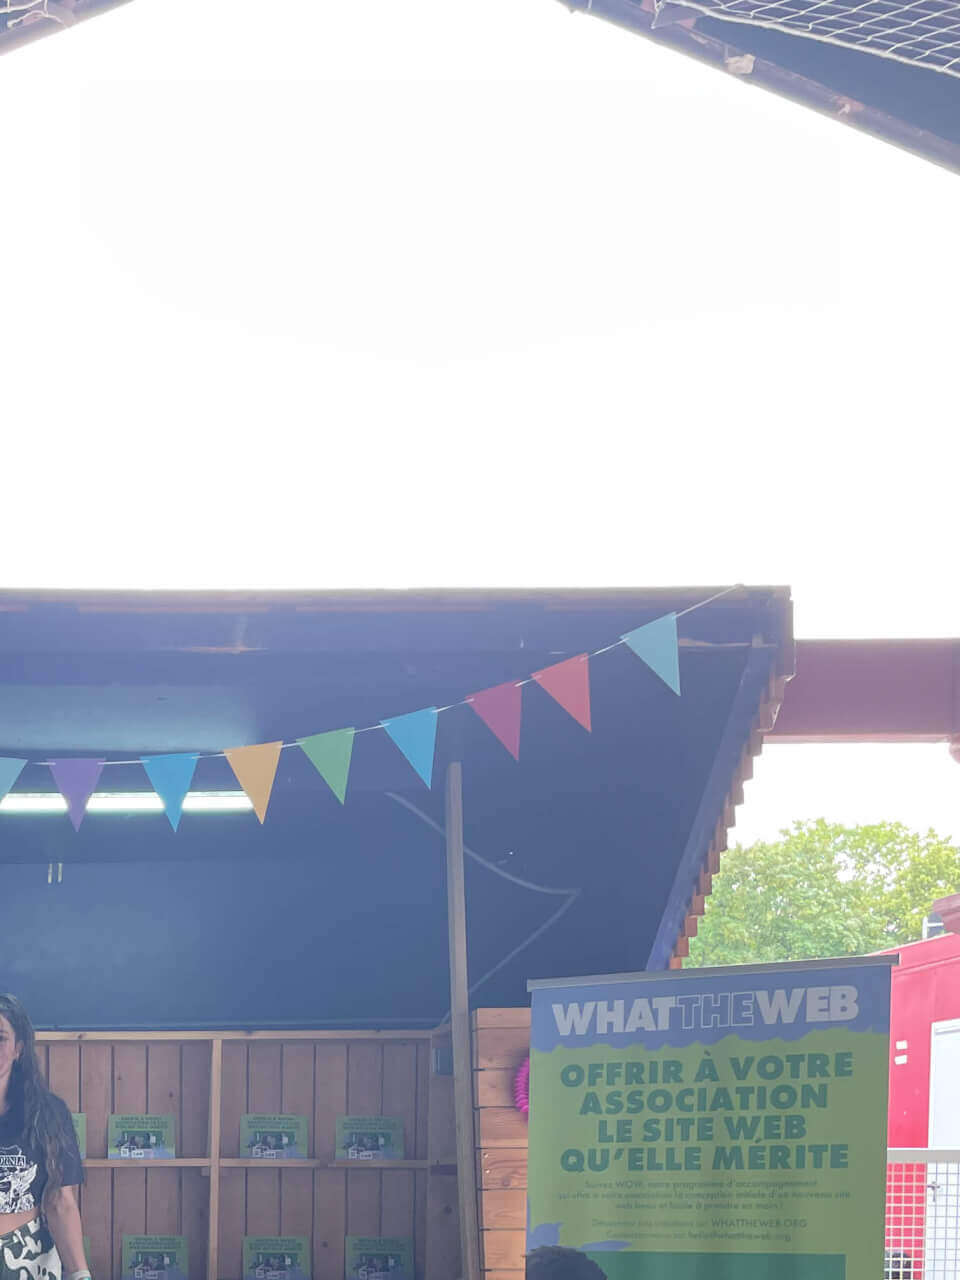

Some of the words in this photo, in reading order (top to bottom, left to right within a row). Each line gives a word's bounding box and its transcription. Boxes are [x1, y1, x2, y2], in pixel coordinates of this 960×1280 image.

[560, 1060, 683, 1087] OFFRIR
[694, 1050, 720, 1082] À
[729, 1051, 853, 1081] VOTRE
[579, 1083, 828, 1115] ASSOCIATION
[598, 1119, 633, 1143] LE
[643, 1118, 713, 1142] SITE
[724, 1115, 807, 1140] WEB
[560, 1147, 702, 1173] QU'ELLE
[712, 1137, 849, 1171] MÉRITE
